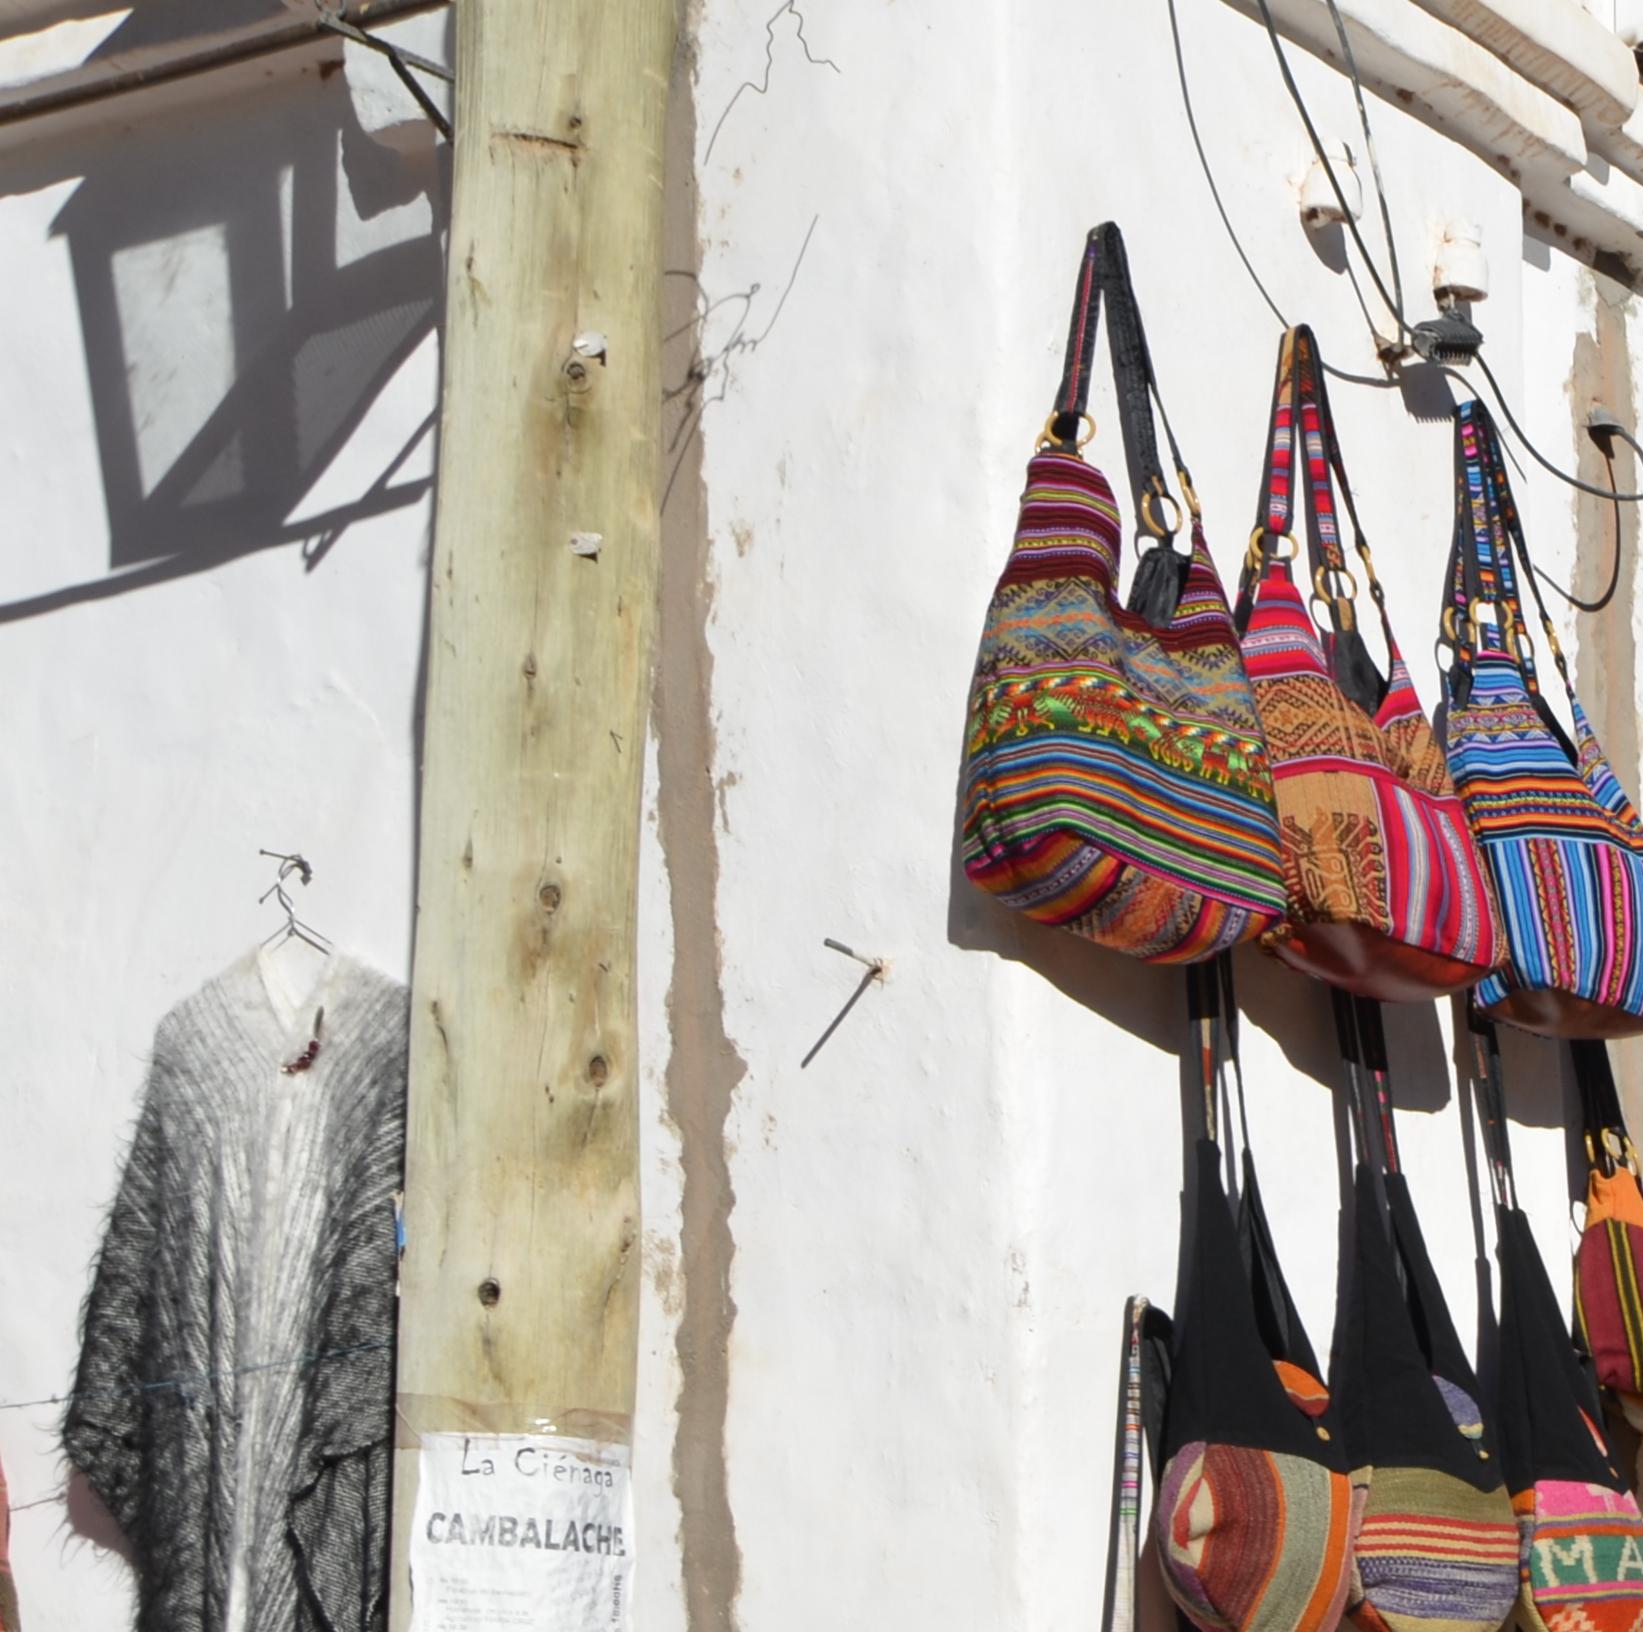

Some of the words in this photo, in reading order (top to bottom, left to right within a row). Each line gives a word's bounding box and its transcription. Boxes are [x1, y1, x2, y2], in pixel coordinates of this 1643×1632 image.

[460, 1437, 495, 1476] La
[514, 1446, 614, 1498] Ciénaga
[425, 1511, 627, 1557] CAMBALACHE
